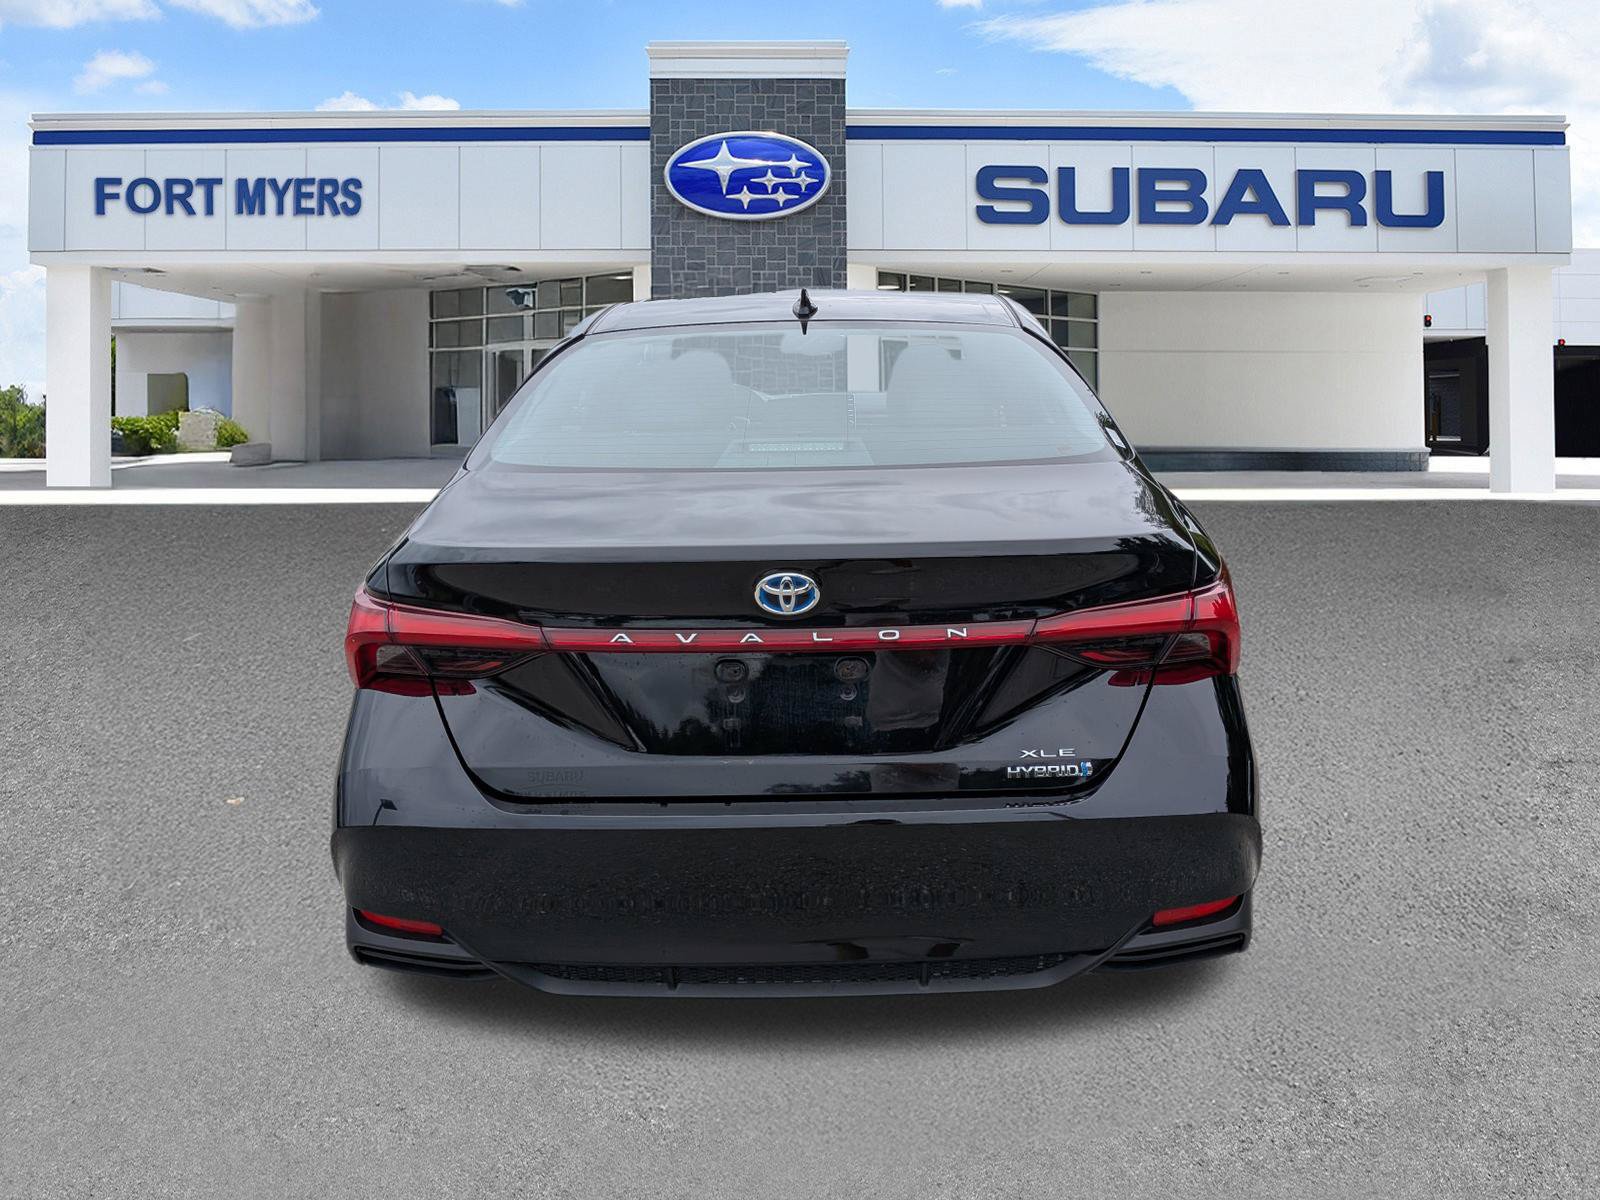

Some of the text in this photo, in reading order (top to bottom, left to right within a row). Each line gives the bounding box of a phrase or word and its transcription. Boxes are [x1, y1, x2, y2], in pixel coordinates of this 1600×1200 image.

[95, 177, 362, 217] FORT MYERS
[975, 165, 1445, 228] SUBARU
[609, 626, 968, 644] AVALON
[1020, 748, 1077, 759] XLE
[1007, 764, 1079, 778] HYBRID
